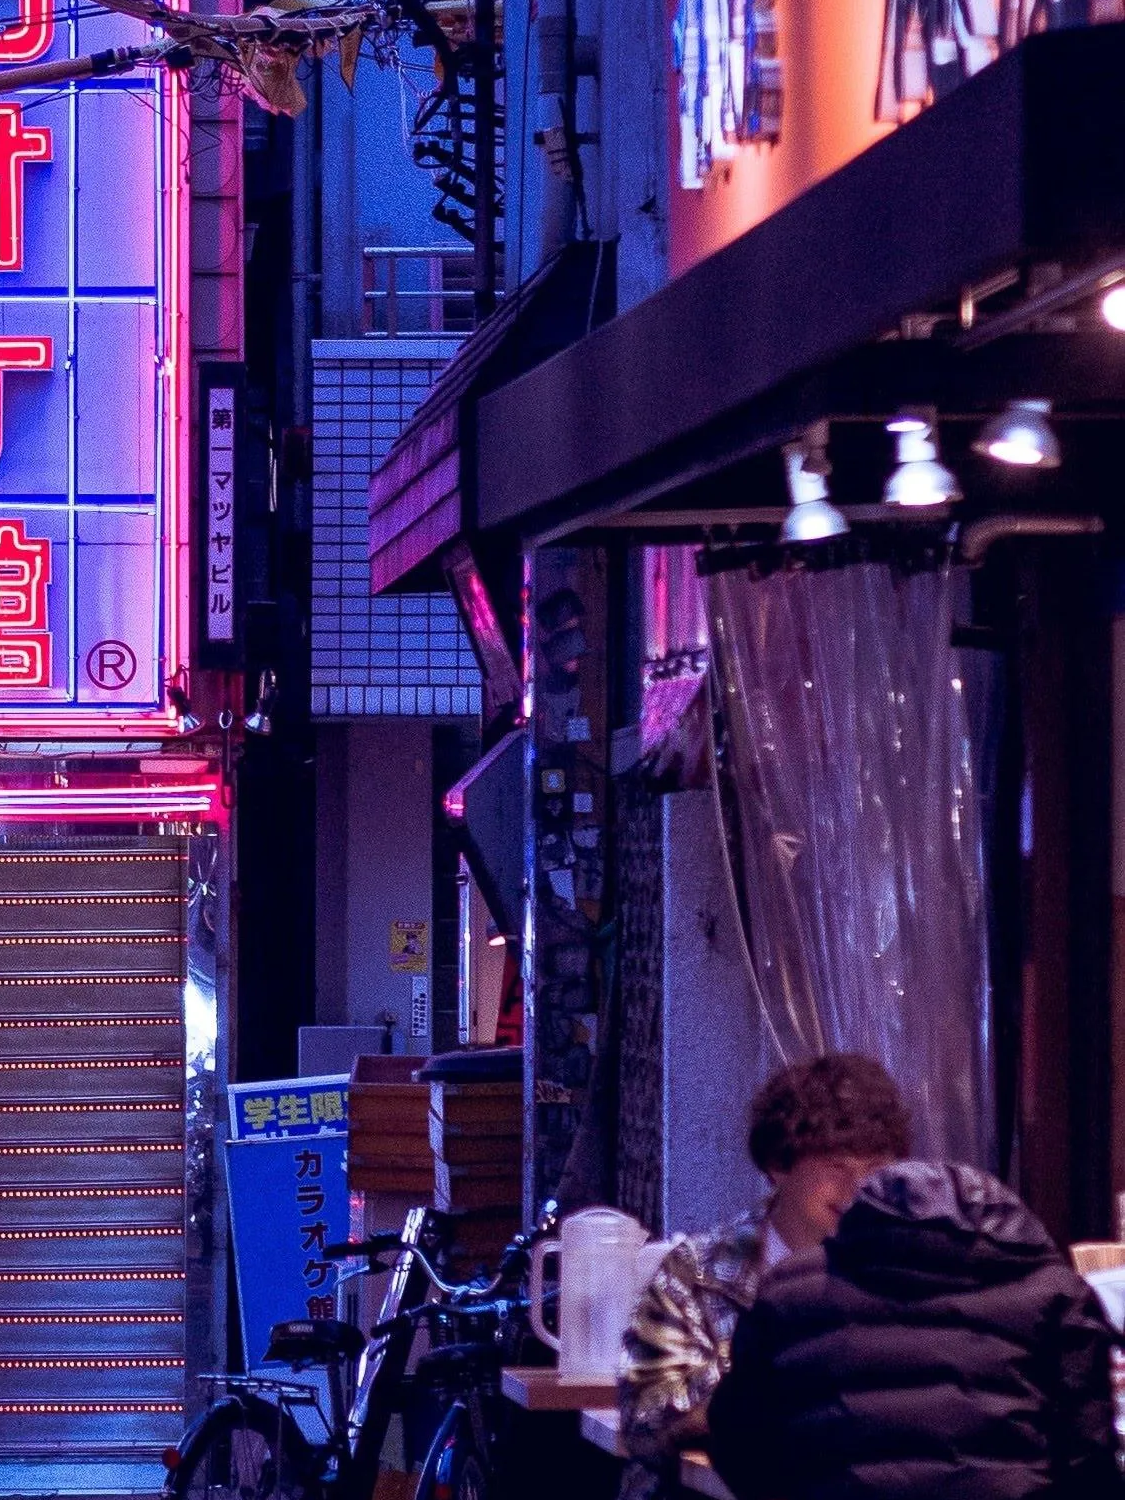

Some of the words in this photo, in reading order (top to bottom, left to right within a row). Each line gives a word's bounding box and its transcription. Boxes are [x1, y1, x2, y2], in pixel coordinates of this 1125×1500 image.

[212, 408, 233, 615] 第一マツヤビル
[244, 1091, 348, 1130] 学生限
